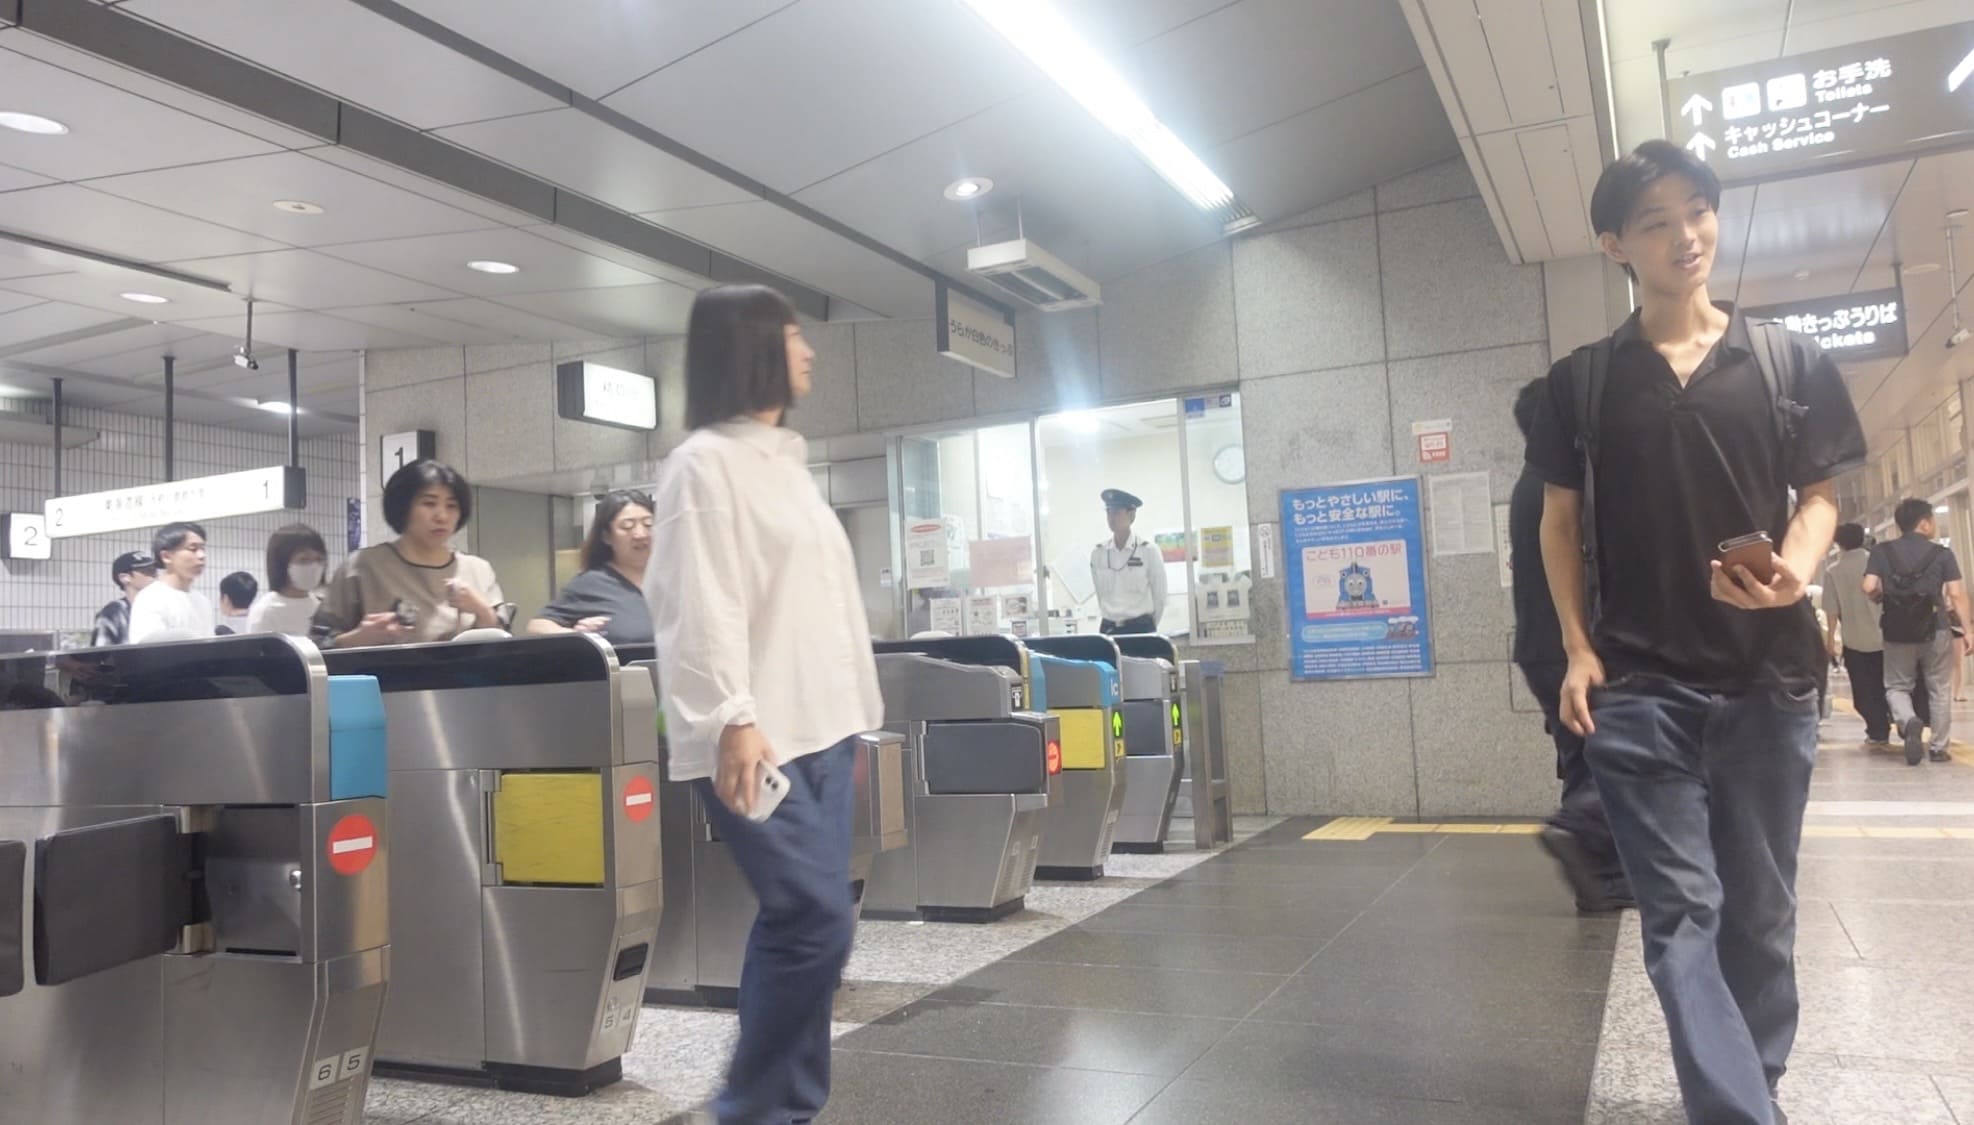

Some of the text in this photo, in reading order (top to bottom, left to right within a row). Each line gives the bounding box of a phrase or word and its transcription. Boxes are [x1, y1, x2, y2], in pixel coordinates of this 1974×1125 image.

[1811, 57, 1893, 90] お手洗
[1815, 83, 1873, 104] Toilets
[1724, 101, 1890, 145] キャッシュコーナー
[1727, 131, 1835, 160] Cash Service
[394, 446, 404, 468] 1
[263, 479, 270, 500] 1
[1292, 488, 1409, 511] もっとやさしい駅に、
[55, 507, 64, 527] 2
[1293, 504, 1401, 526] もっと安全な駅に。
[23, 525, 39, 547] 2
[1306, 542, 1402, 562] こども110番の駅
[318, 1054, 361, 1081] 6 5
